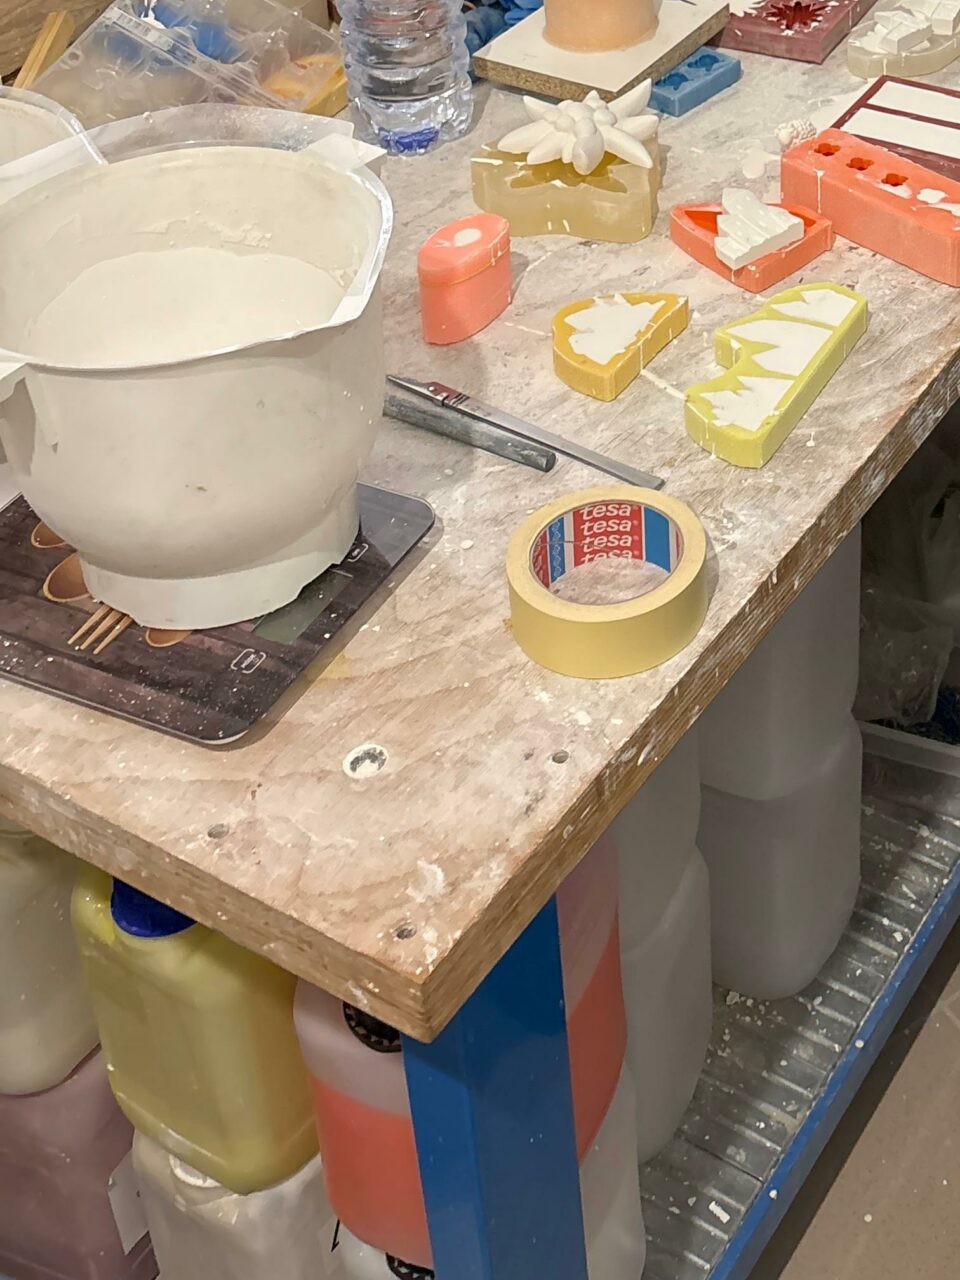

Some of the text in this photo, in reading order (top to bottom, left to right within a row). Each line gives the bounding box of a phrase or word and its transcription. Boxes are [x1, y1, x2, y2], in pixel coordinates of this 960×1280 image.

[579, 503, 632, 520] tesa
[580, 519, 632, 536] tesa
[580, 534, 632, 552] tesa
